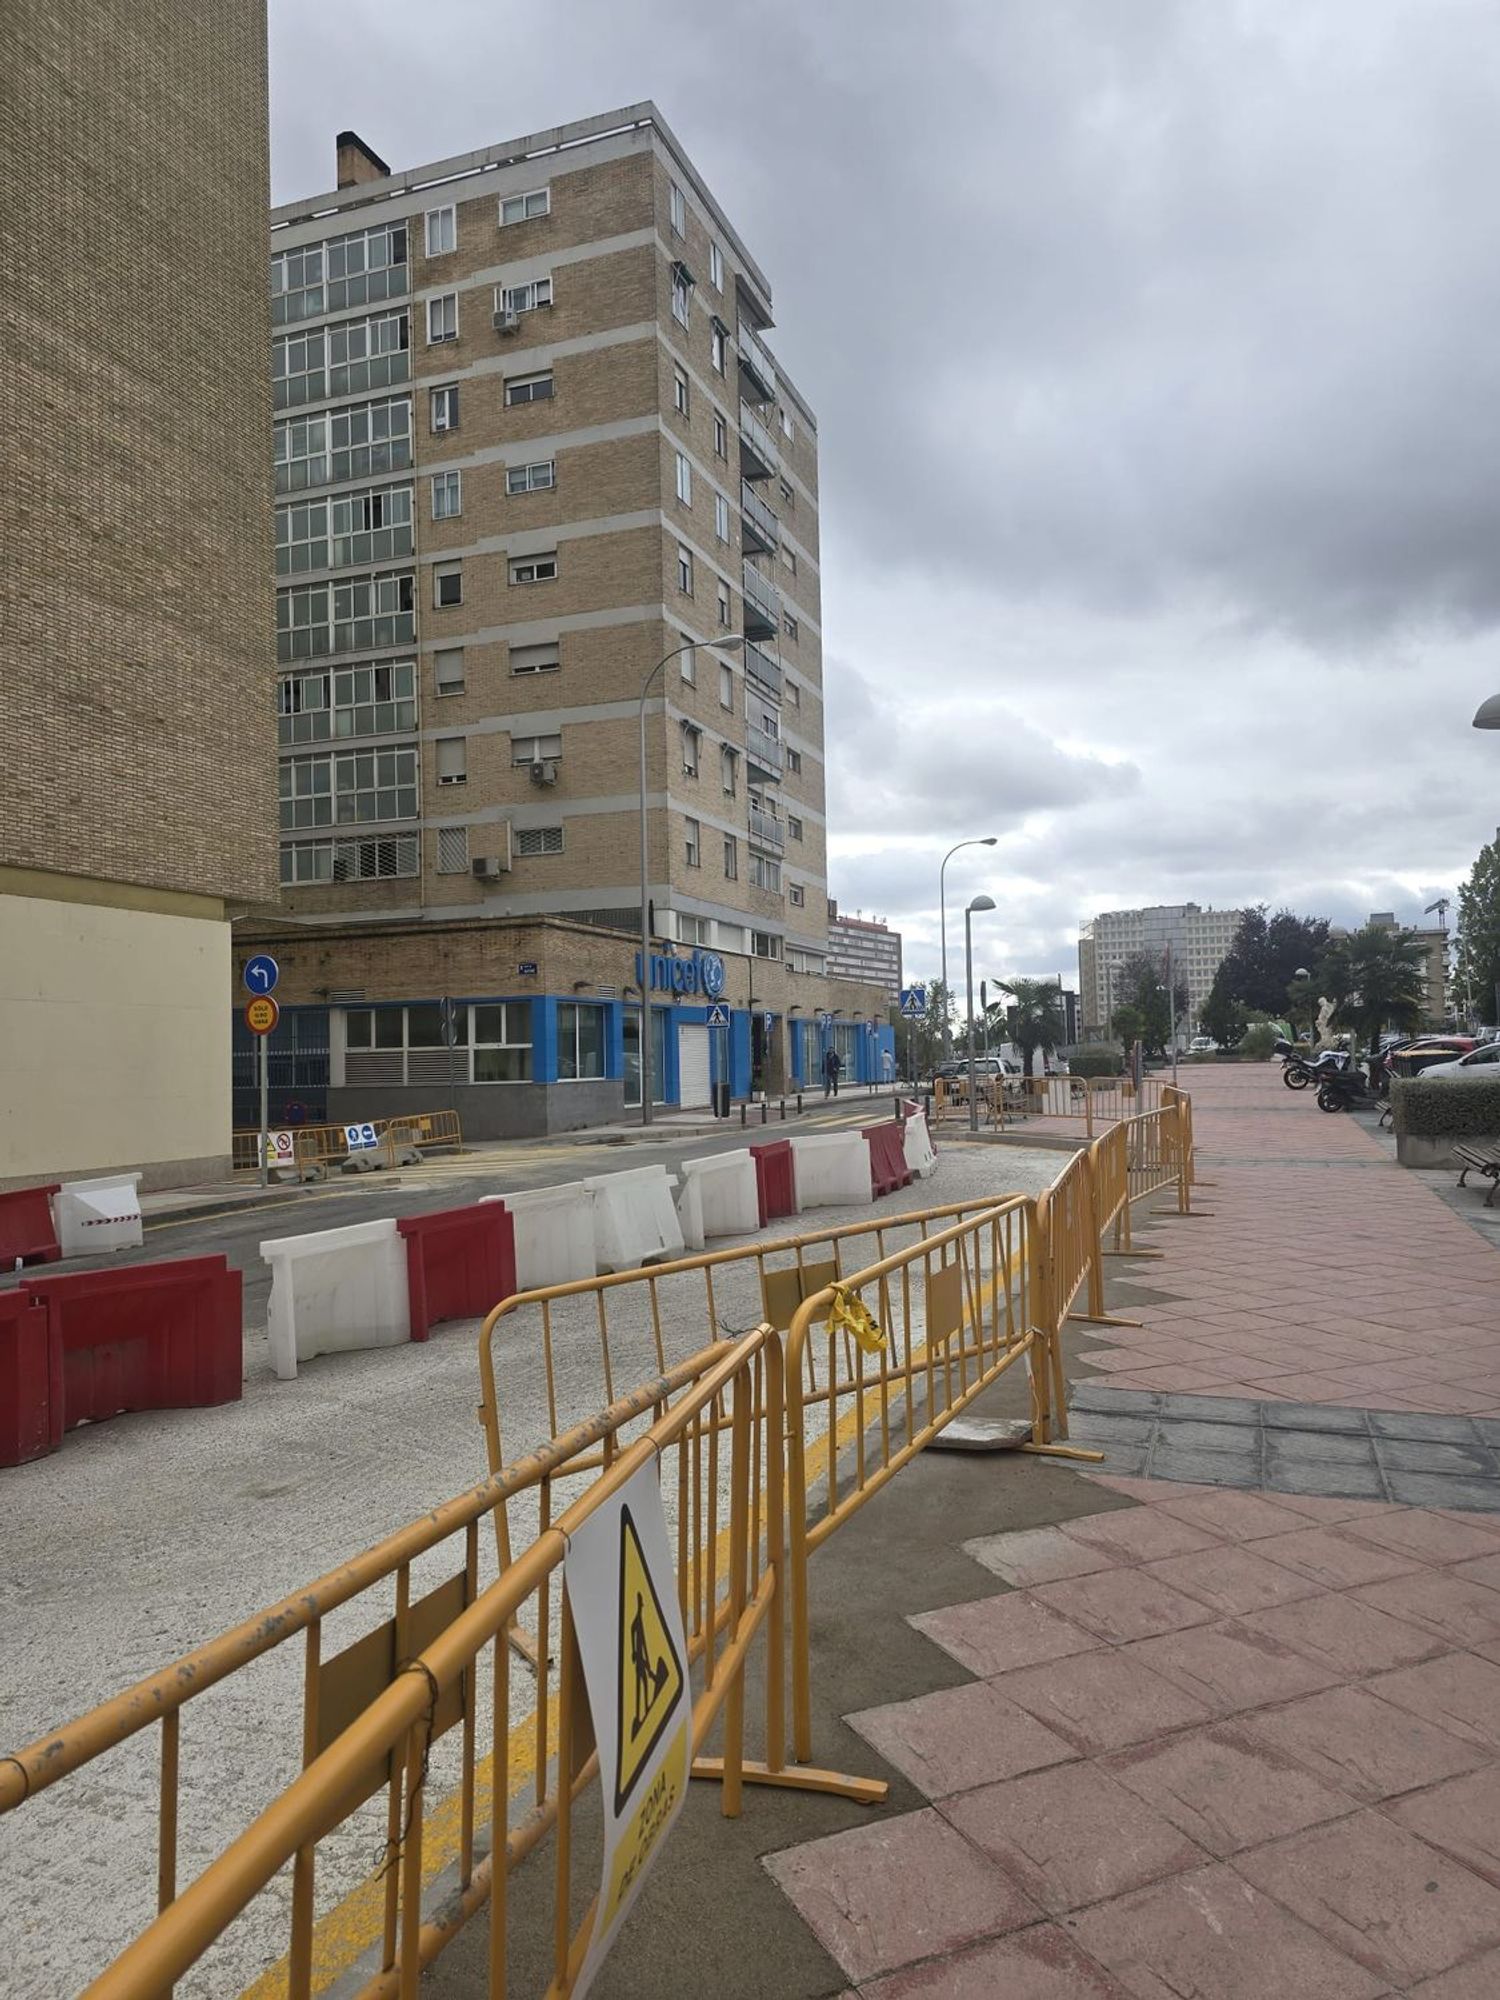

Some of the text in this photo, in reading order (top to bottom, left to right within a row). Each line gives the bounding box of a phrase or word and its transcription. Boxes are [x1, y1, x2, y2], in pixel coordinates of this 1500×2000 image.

[617, 1783, 676, 1903] DE OBRAS
[638, 1771, 667, 1840] ZONA
